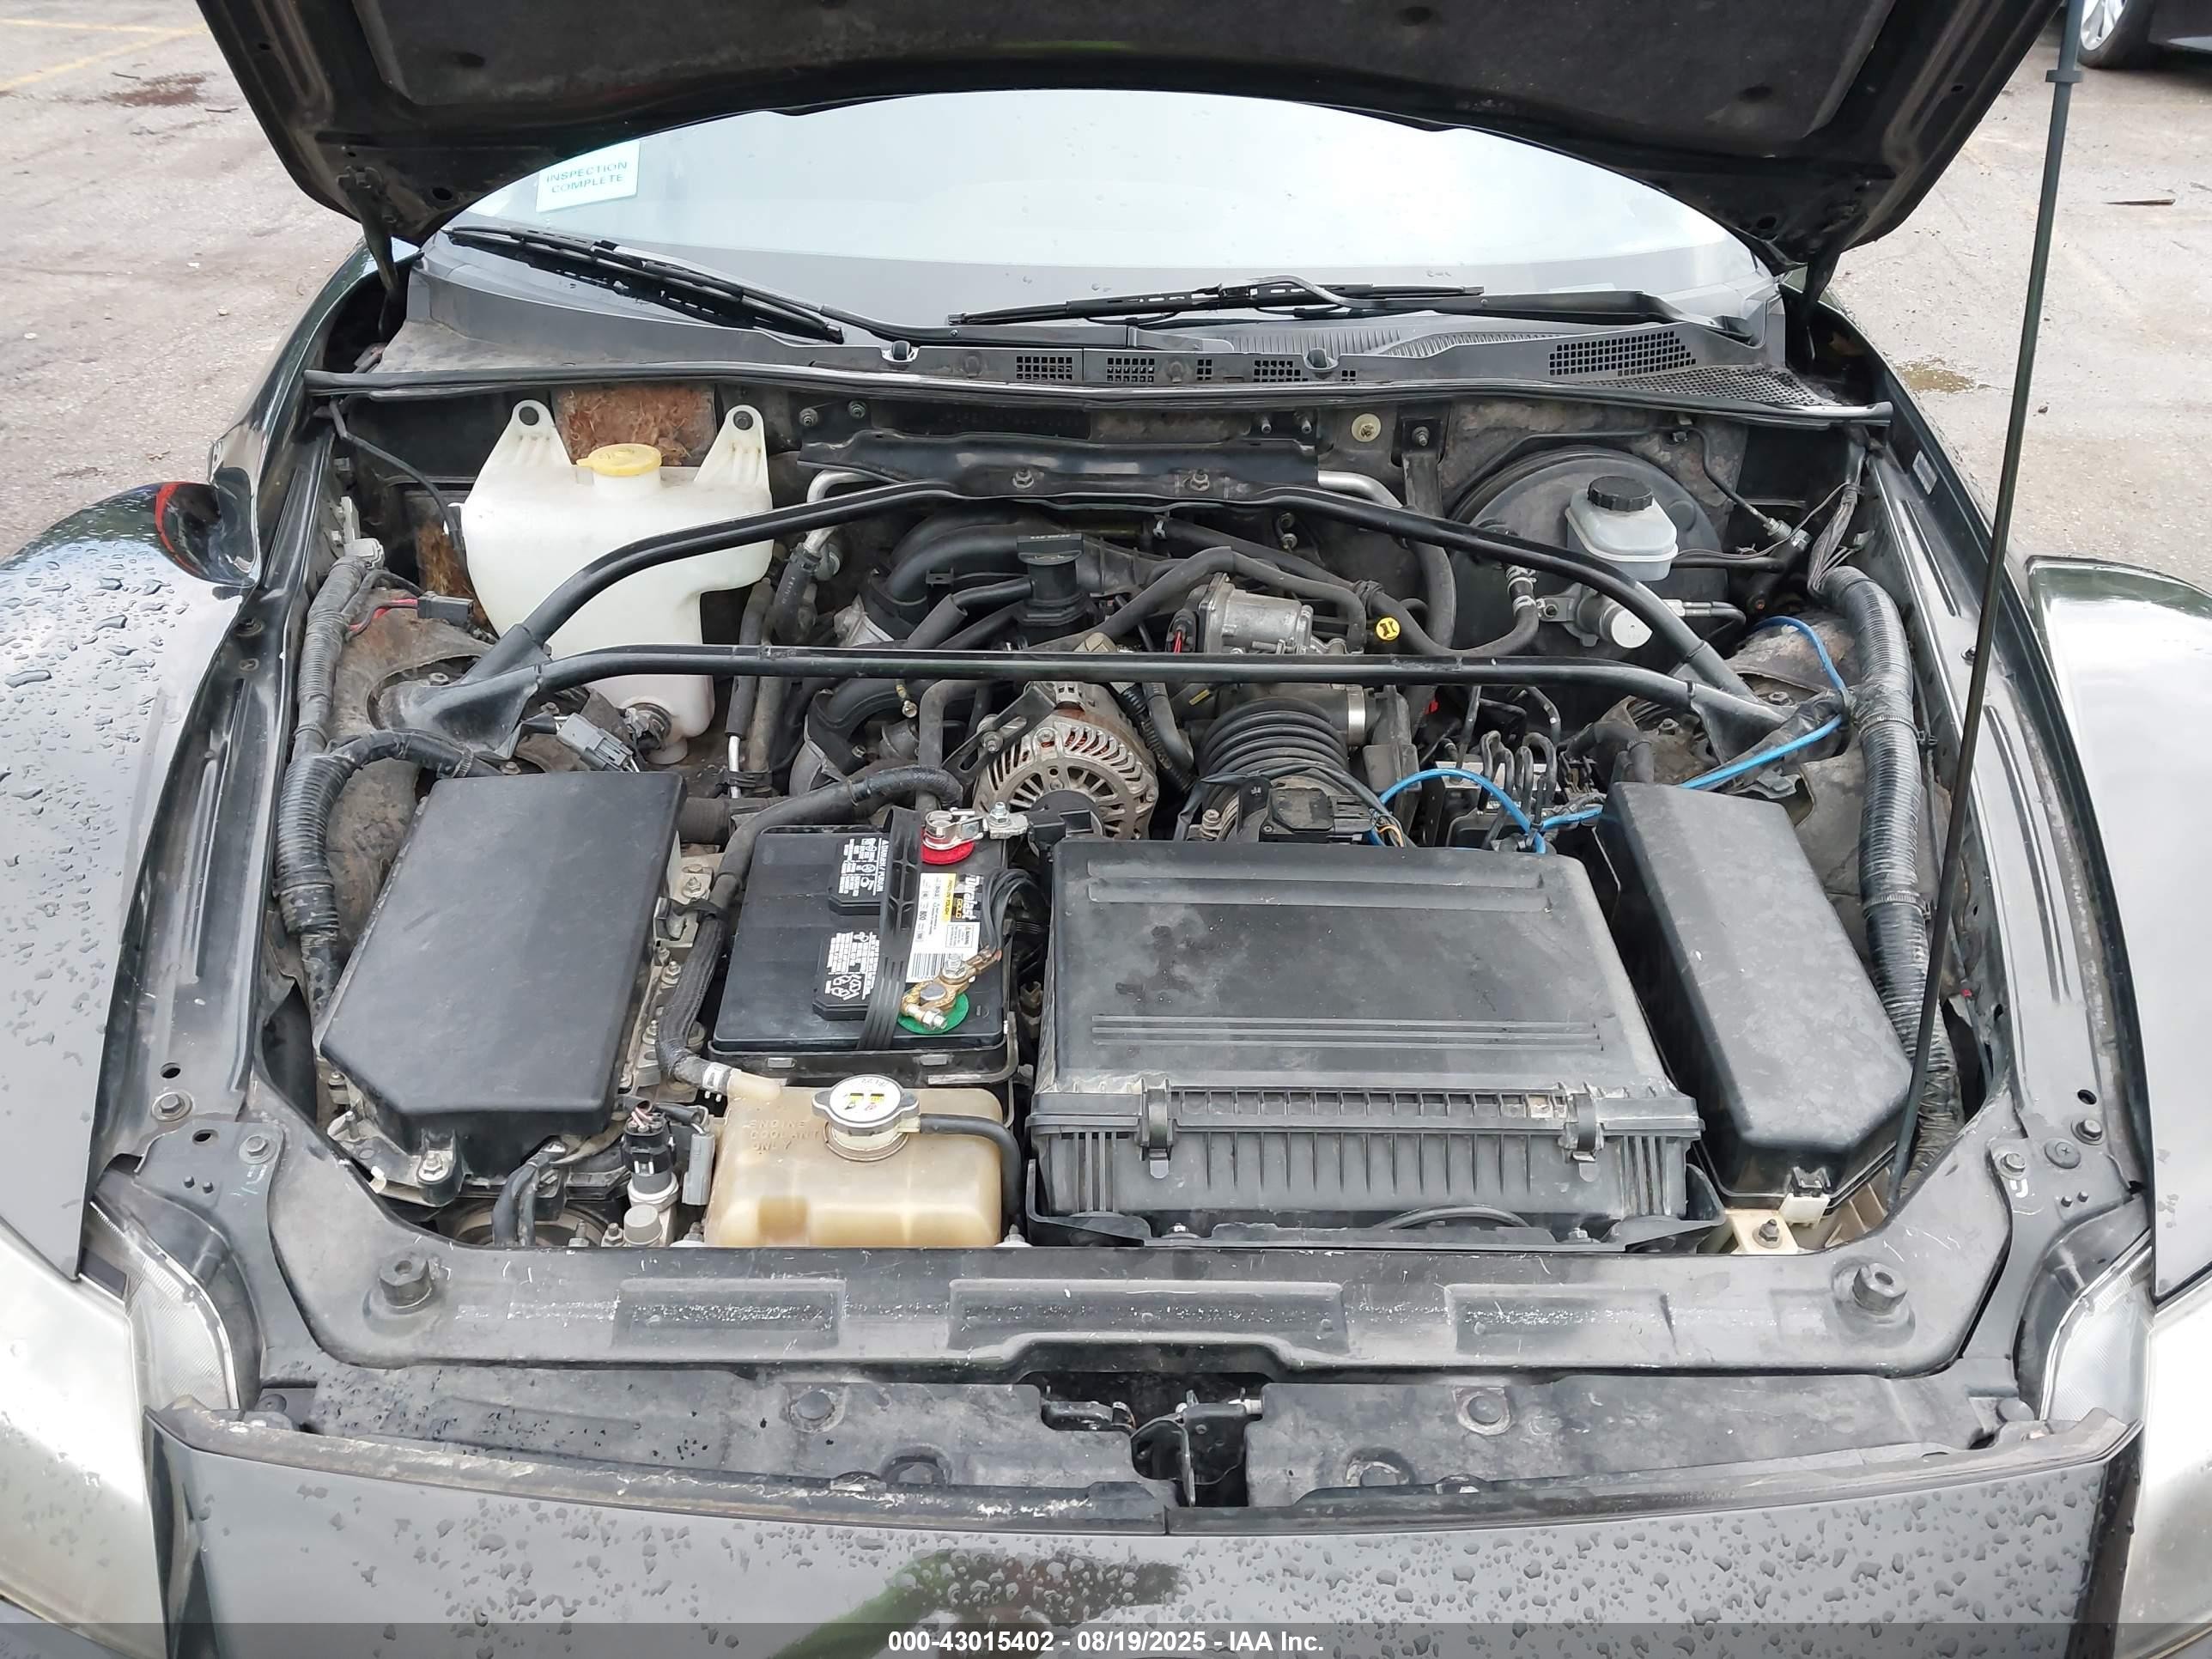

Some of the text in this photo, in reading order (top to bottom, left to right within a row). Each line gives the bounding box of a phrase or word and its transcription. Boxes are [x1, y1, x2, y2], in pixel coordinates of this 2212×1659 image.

[546, 161, 629, 183] INSPECTION
[551, 173, 623, 193] COMPLETE
[963, 875, 981, 921] Duralast
[748, 1119, 806, 1128] ENGINE
